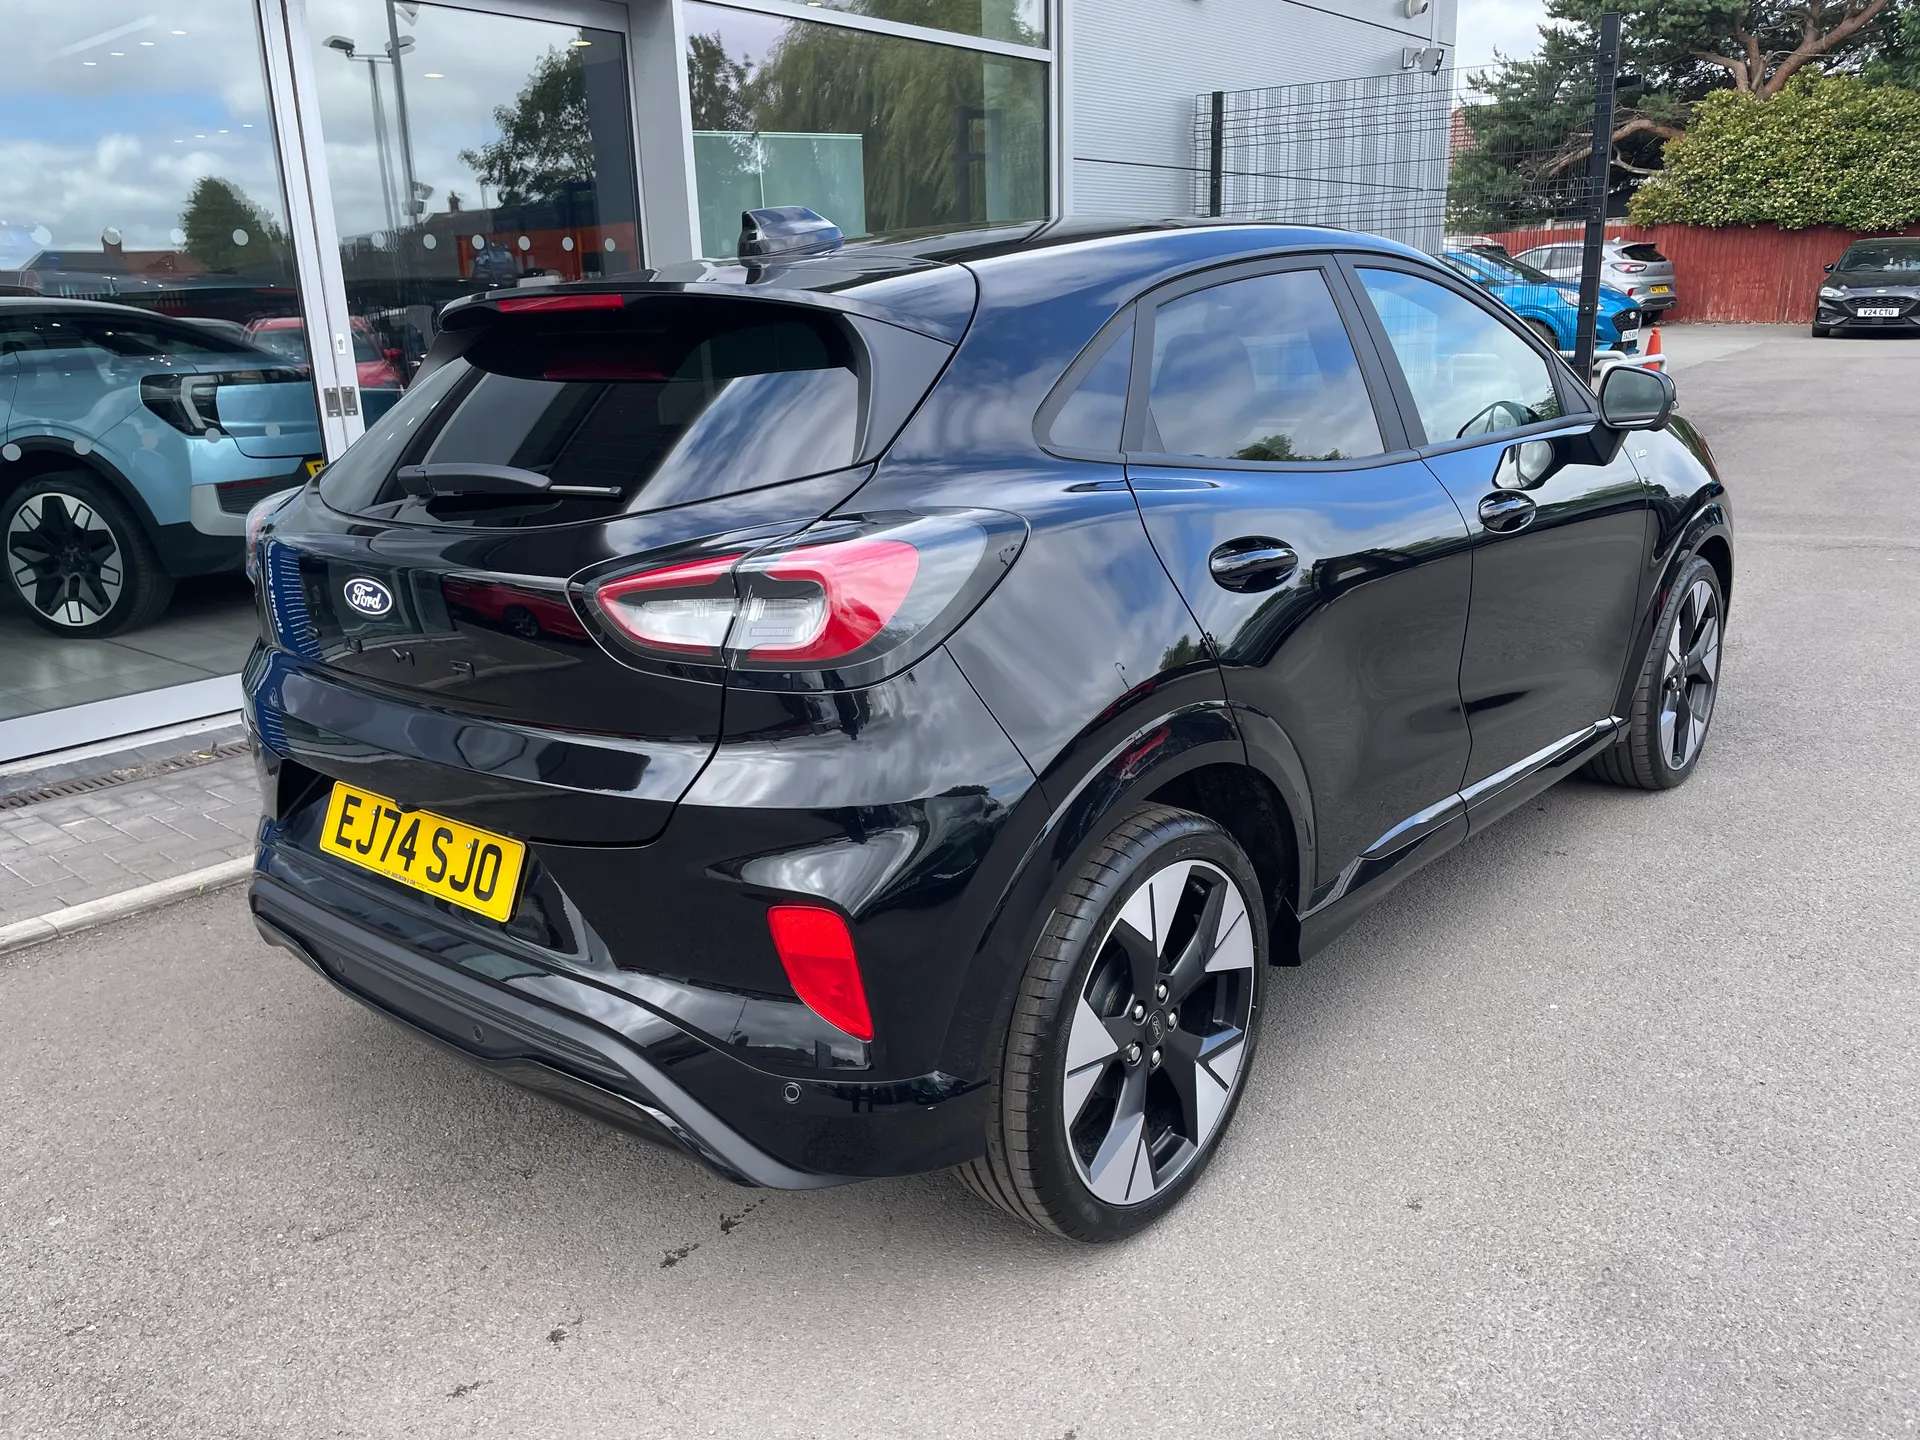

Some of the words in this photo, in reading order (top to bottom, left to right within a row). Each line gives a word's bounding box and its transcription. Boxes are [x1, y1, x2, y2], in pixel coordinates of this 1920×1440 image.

[352, 583, 382, 610] Ford
[335, 794, 421, 871] EJ74
[425, 826, 503, 902] SJO
